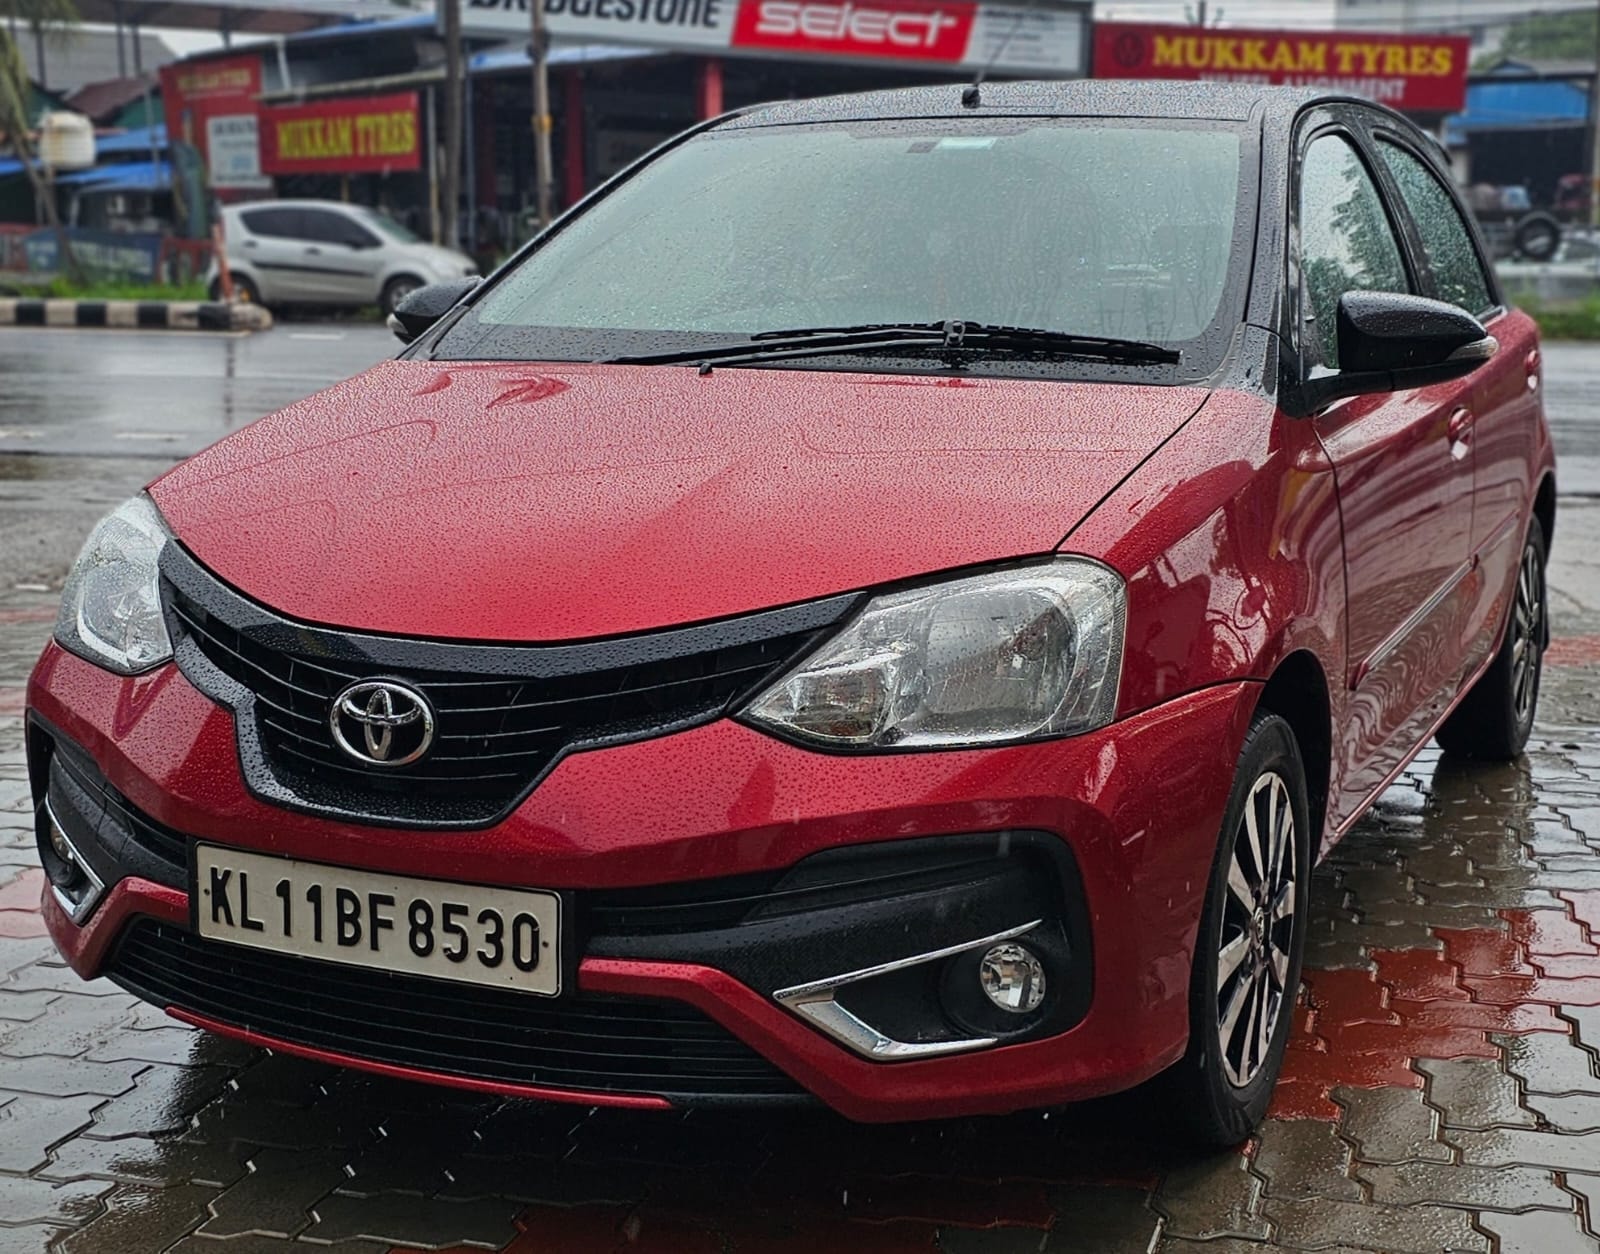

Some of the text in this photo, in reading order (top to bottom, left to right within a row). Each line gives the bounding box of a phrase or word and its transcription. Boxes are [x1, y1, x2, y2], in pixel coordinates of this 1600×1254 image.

[468, 0, 721, 29] DGESTONE
[1153, 36, 1452, 76] MUKKAM TYRES
[278, 111, 416, 160] MUKKAM TYRES
